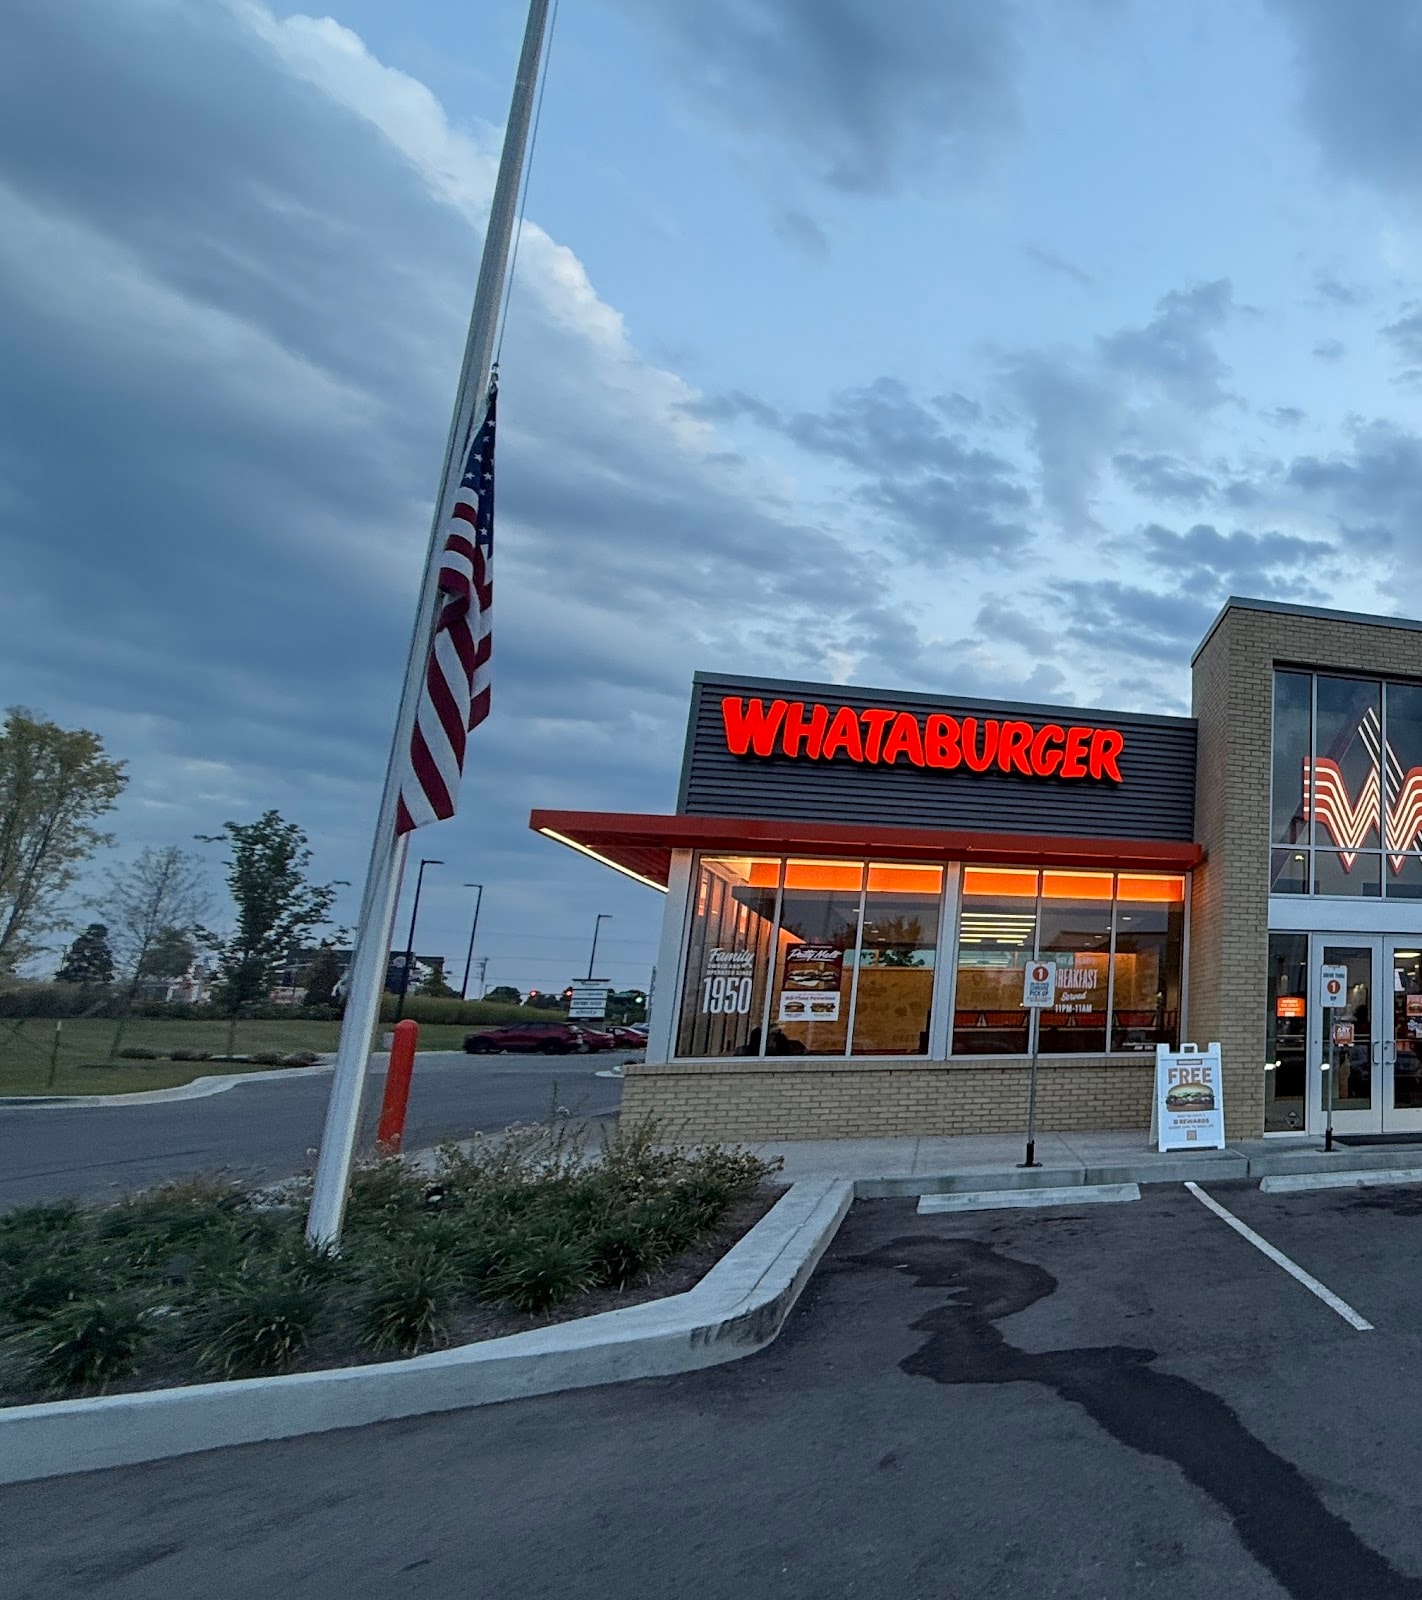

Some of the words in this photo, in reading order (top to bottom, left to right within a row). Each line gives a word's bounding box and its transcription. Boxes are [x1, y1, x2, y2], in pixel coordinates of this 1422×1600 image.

[721, 696, 1124, 783] WHATABURGER
[709, 947, 755, 967] Family
[786, 948, 817, 961] Patty
[1037, 968, 1044, 980] 1
[702, 976, 753, 1014] 1950
[1061, 990, 1088, 1002] Served
[1055, 1004, 1093, 1013] 11PM-11AM
[1168, 1067, 1213, 1084] FREE
